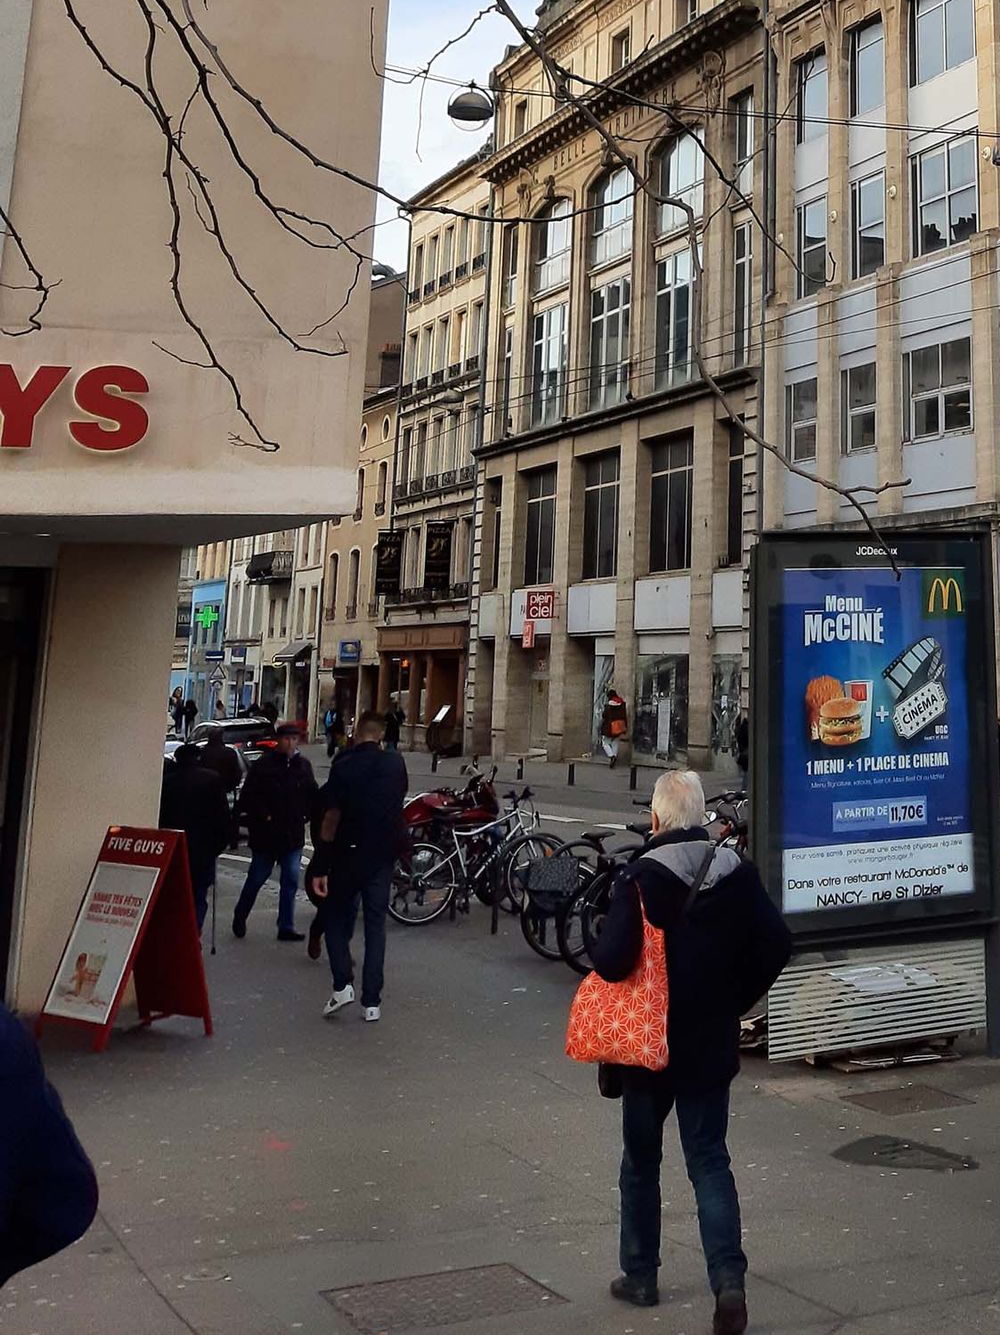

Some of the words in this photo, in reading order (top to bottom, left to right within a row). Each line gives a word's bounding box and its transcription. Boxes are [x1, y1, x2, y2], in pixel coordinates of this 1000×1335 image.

[553, 138, 586, 171] BELLE
[0, 364, 150, 451] YS
[529, 593, 553, 606] plein
[825, 595, 863, 612] Menu
[529, 604, 553, 618] ciel
[804, 608, 885, 646] McCINÉ
[902, 693, 938, 725] CINEMA
[806, 761, 812, 775] 1
[814, 759, 845, 775] MENU
[856, 758, 862, 772] 1
[864, 756, 896, 771] PLACE
[899, 754, 911, 769] DE
[913, 752, 949, 767] CINEMA
[844, 808, 875, 818] PARTIR
[877, 806, 888, 816] DE
[108, 837, 132, 852] FIVE
[134, 840, 165, 855] GUYS
[787, 879, 814, 890] Dans
[817, 876, 841, 887] votre
[844, 871, 892, 885] restaurant
[957, 863, 969, 873] de
[872, 889, 892, 902] rue
[896, 886, 909, 899] St
[912, 884, 944, 897] Dizier
